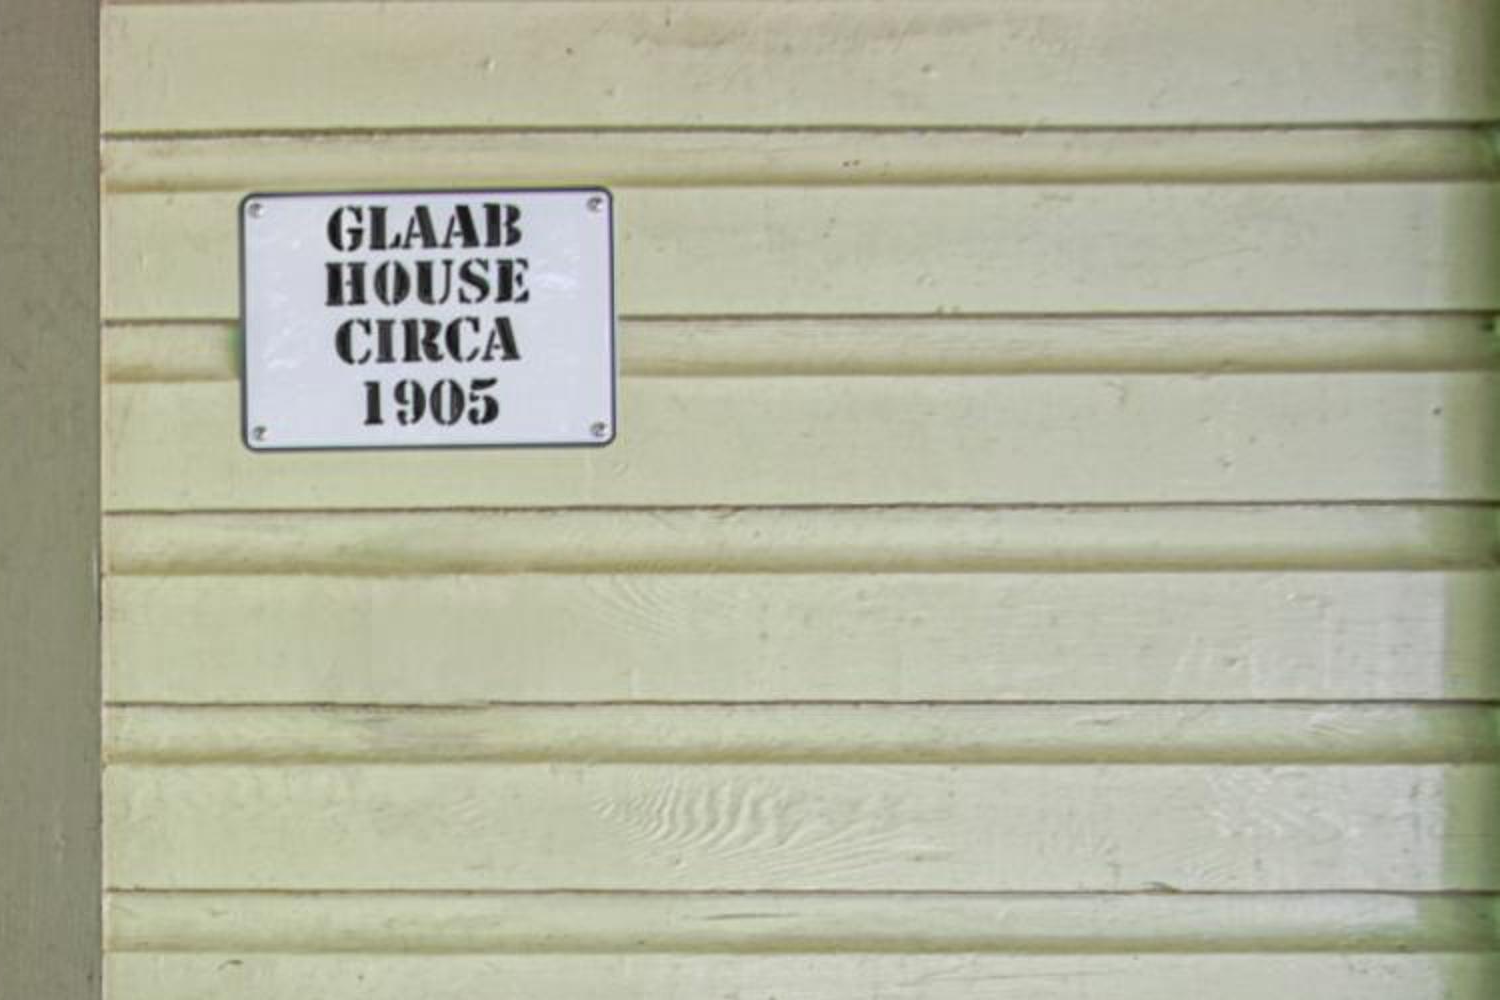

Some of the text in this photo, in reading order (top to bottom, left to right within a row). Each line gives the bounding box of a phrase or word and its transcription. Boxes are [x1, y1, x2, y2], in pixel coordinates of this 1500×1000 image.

[327, 203, 521, 252] GLAAB
[326, 258, 529, 307] HOUSE
[336, 317, 520, 364] CIRCA
[365, 378, 499, 425] 1905
